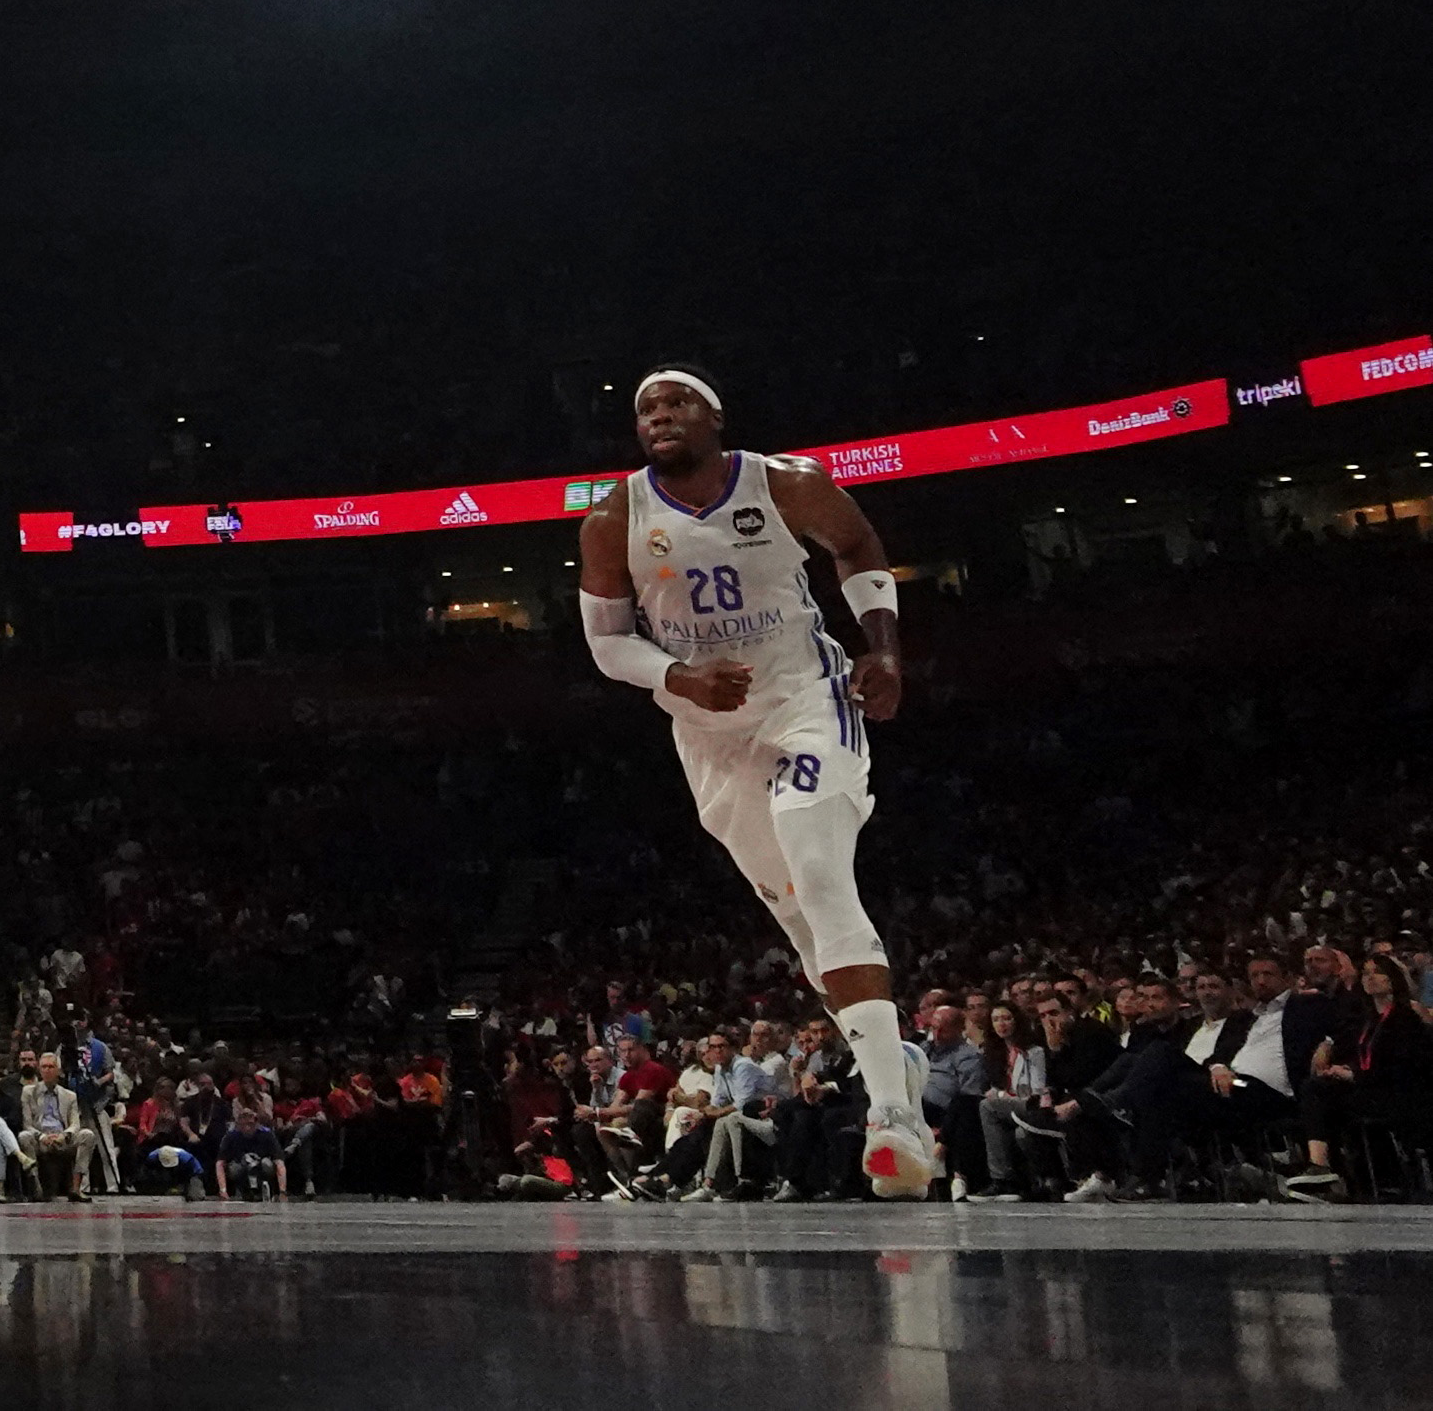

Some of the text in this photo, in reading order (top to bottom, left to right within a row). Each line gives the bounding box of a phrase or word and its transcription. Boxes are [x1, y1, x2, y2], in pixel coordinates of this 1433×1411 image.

[829, 443, 900, 465] TURKISH
[831, 458, 903, 480] AIRLINES
[314, 510, 380, 529] SPALDING
[440, 511, 488, 525] adidas
[58, 520, 171, 539] #F4GLORY
[687, 565, 744, 615] 28
[661, 607, 784, 639] PALLADIUM
[775, 753, 821, 797] 28
